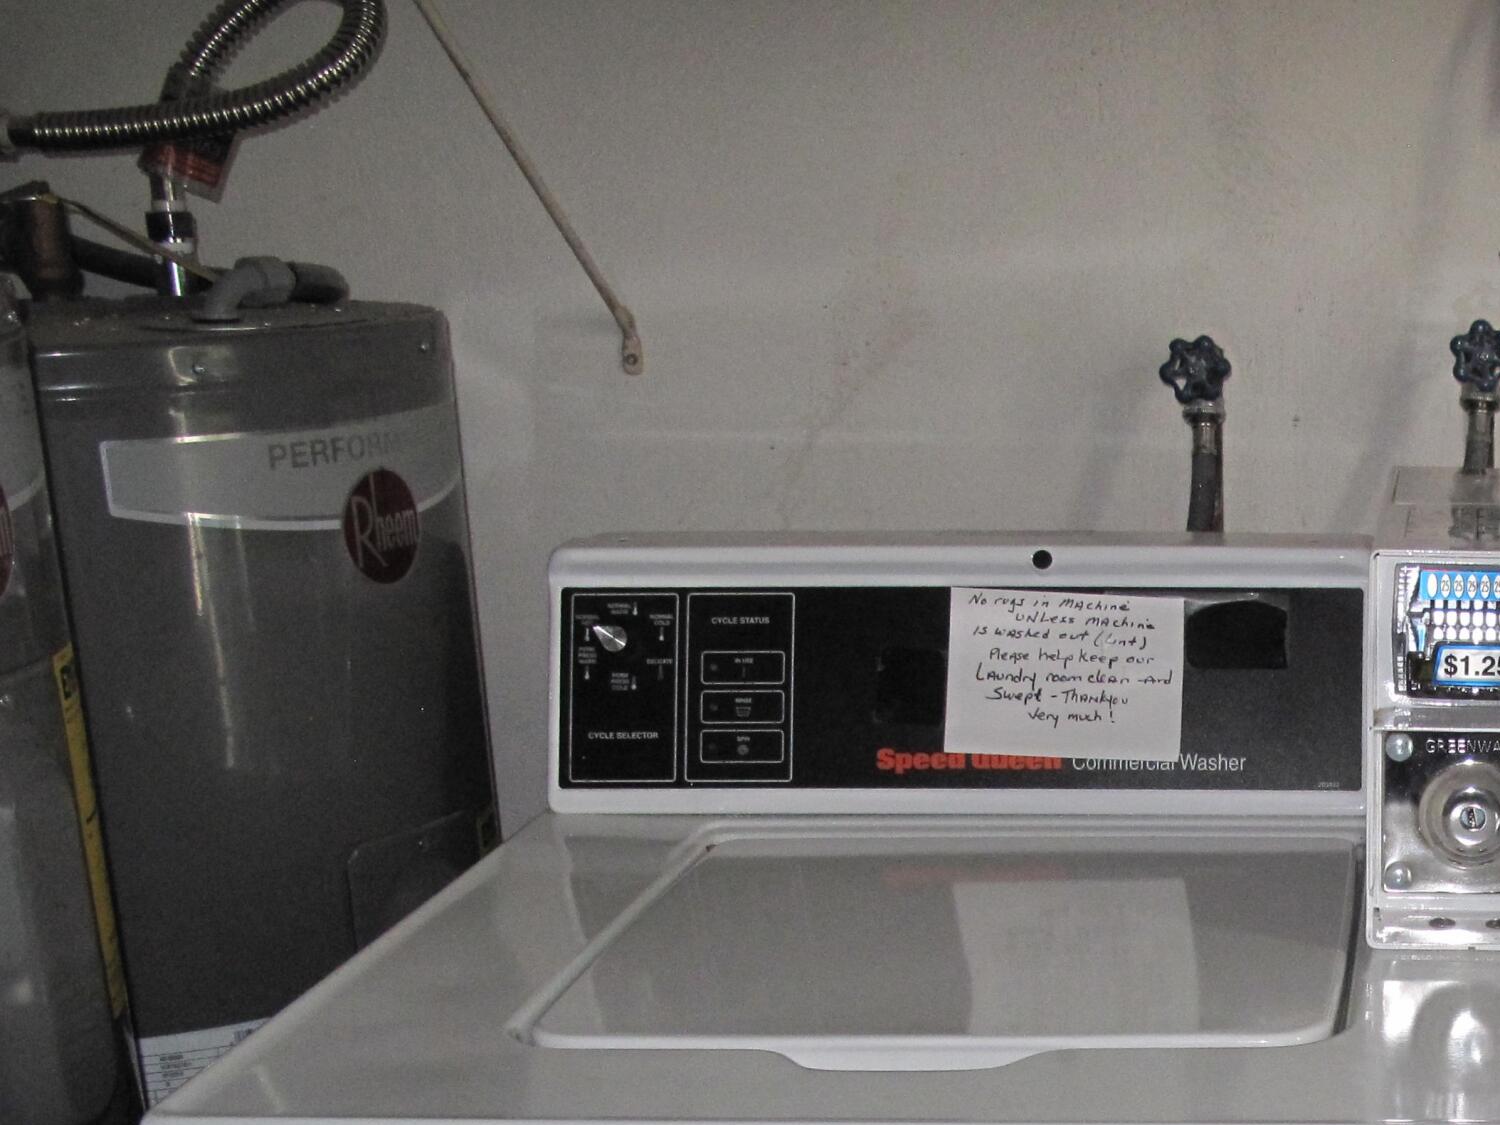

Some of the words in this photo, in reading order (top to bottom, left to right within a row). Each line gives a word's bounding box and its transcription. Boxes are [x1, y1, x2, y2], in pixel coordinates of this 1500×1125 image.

[350, 471, 417, 567] Rheem
[1441, 580, 1450, 592] 25
[1454, 580, 1463, 592] 25
[1468, 580, 1476, 592] 25
[1481, 580, 1489, 592] 25
[968, 592, 987, 605] No
[994, 597, 1025, 613] rugs
[1033, 594, 1049, 607] in
[739, 616, 770, 624] STATUS
[1059, 630, 1089, 641] out
[1126, 656, 1155, 664] our
[1046, 672, 1082, 682] room
[984, 686, 1043, 705] Swept
[588, 732, 614, 740] CYCLE
[616, 731, 659, 740] SELECTOR
[876, 747, 966, 775] Speed
[970, 753, 1063, 770] Queen
[1180, 753, 1247, 772] Washer
